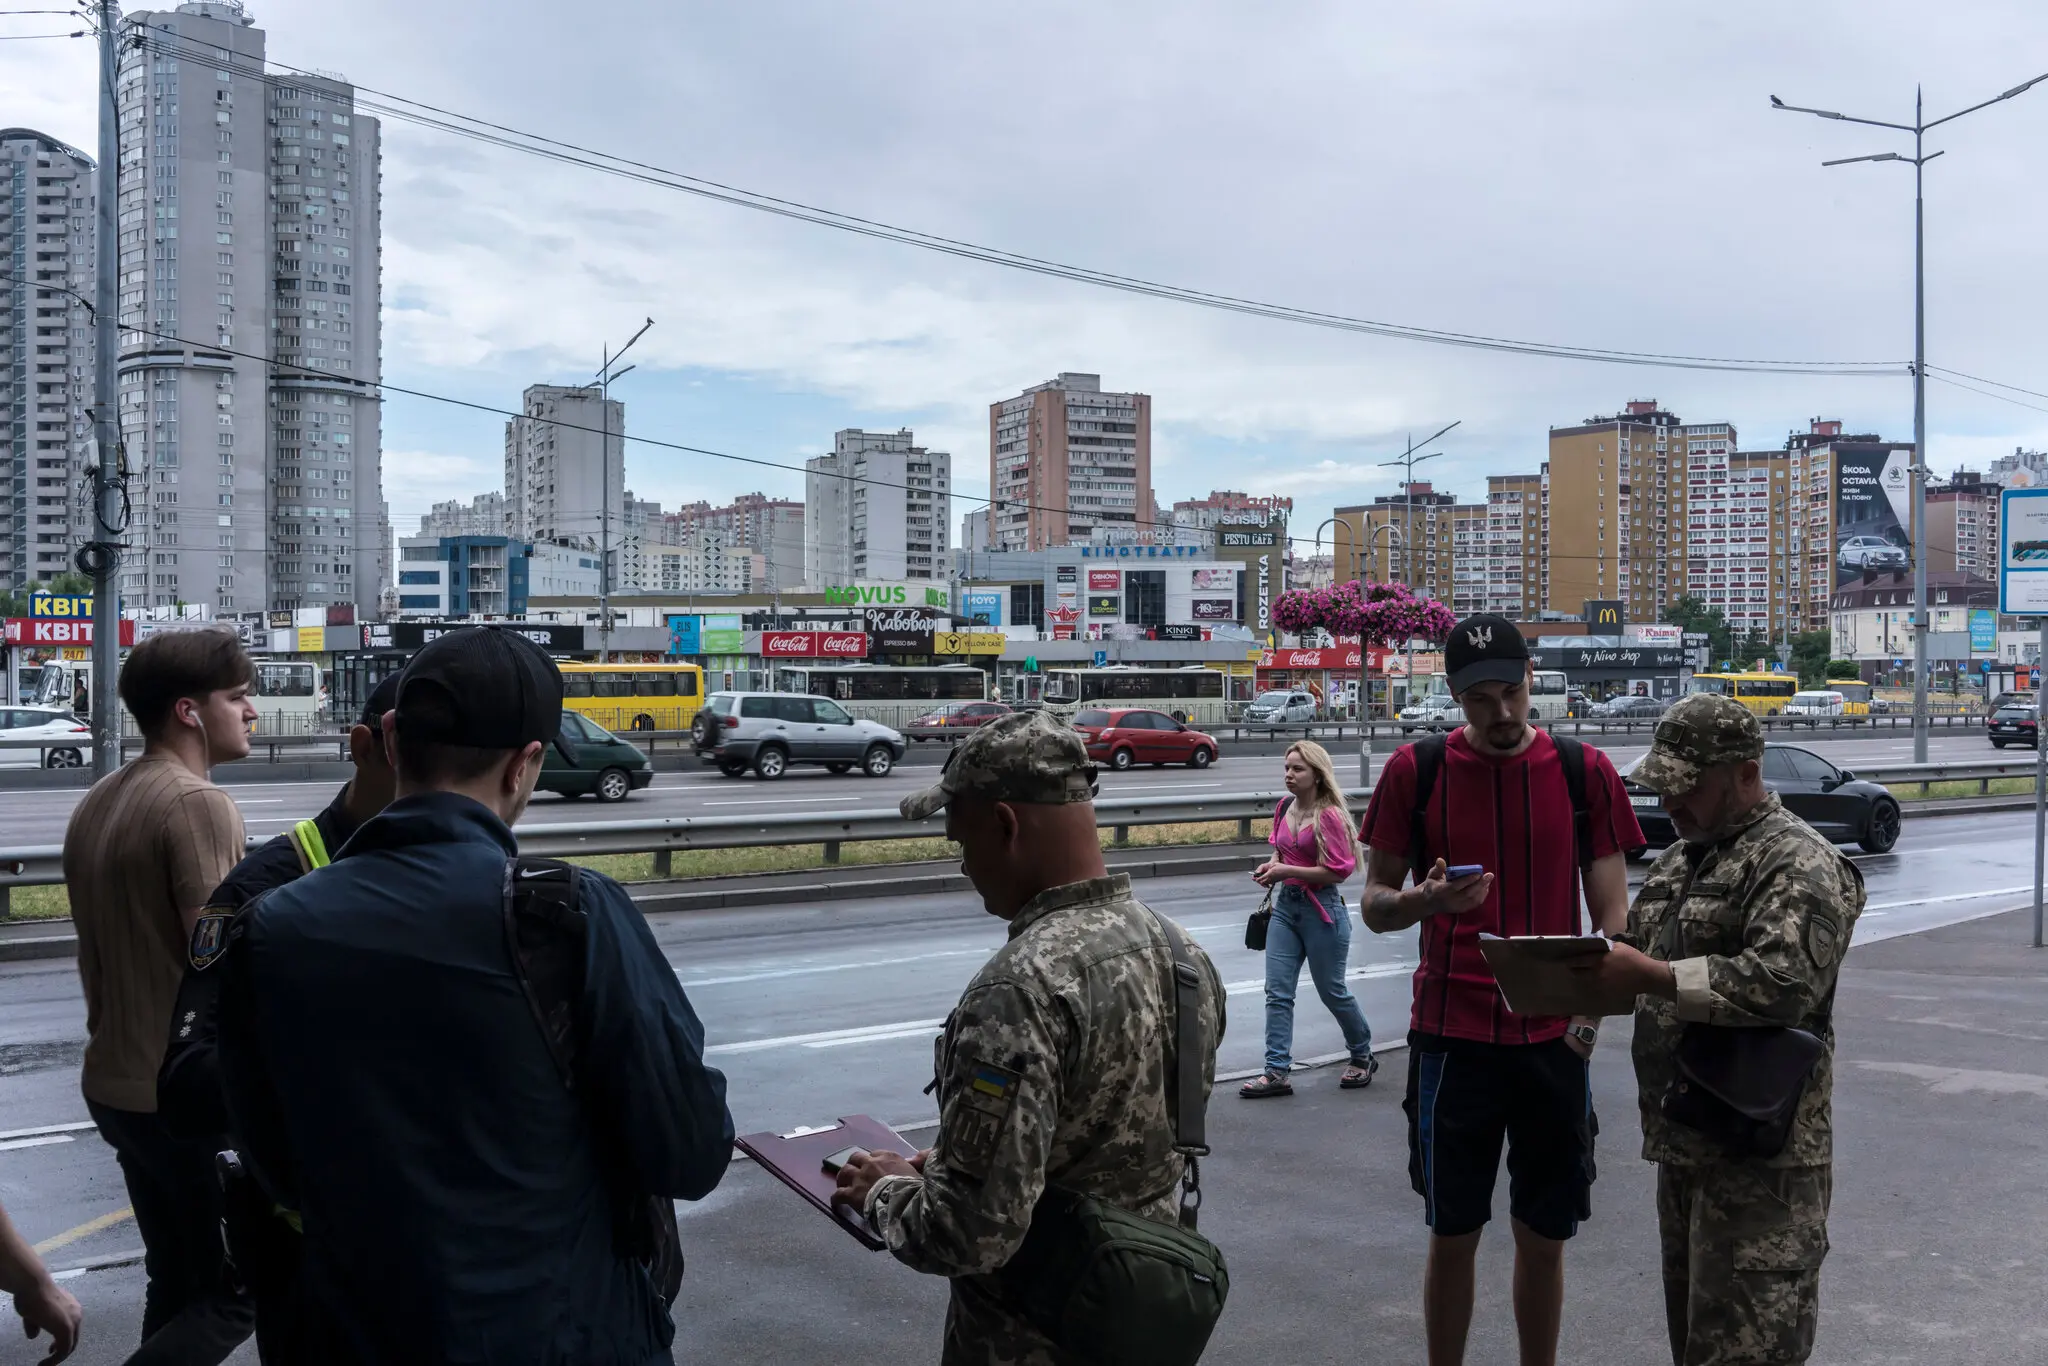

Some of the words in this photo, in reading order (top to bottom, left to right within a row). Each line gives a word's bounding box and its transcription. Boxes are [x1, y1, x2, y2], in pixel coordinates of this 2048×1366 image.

[1842, 465, 1871, 474] ŠKODA
[1842, 477, 1878, 485] OCTAVIA
[1082, 546, 1198, 558] КІНОТЕАТР
[825, 586, 906, 605] NOVUS
[1258, 554, 1269, 629] ROZETKA
[34, 597, 94, 616] КВІТ
[34, 623, 94, 641] КВІТ
[769, 635, 811, 652] Coca-Cola
[823, 636, 863, 652] Coca-Cola
[64, 650, 85, 660] 24/7
[1289, 651, 1321, 667] Coca-Cola
[1580, 650, 1591, 667] by
[1594, 649, 1616, 662] Nino
[1620, 649, 1641, 666] shop
